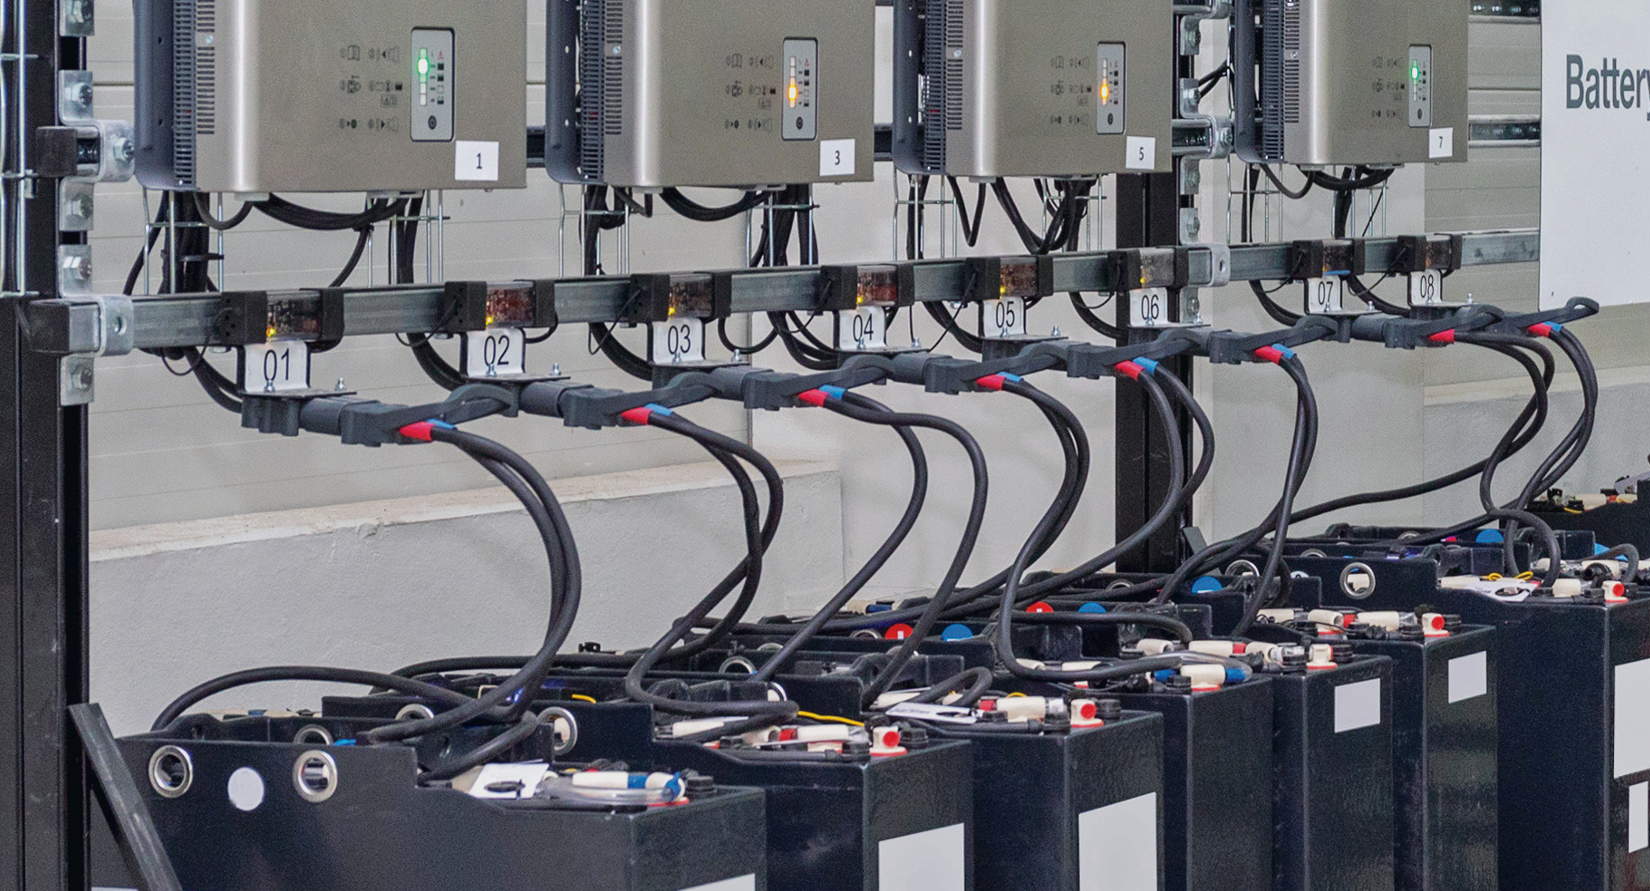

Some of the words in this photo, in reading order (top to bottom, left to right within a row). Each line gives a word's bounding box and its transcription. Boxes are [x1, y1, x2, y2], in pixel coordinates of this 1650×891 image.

[1139, 146, 1145, 161] 5
[1438, 136, 1444, 149] 7
[476, 152, 483, 170] 1
[834, 150, 841, 166] 3
[1317, 281, 1334, 305] 07
[1420, 274, 1435, 299] 08
[995, 301, 1015, 329] 05
[1141, 294, 1160, 321] 06
[667, 324, 691, 355] 03
[853, 313, 874, 342] 04
[484, 335, 510, 366] 02
[264, 348, 290, 381] 01
